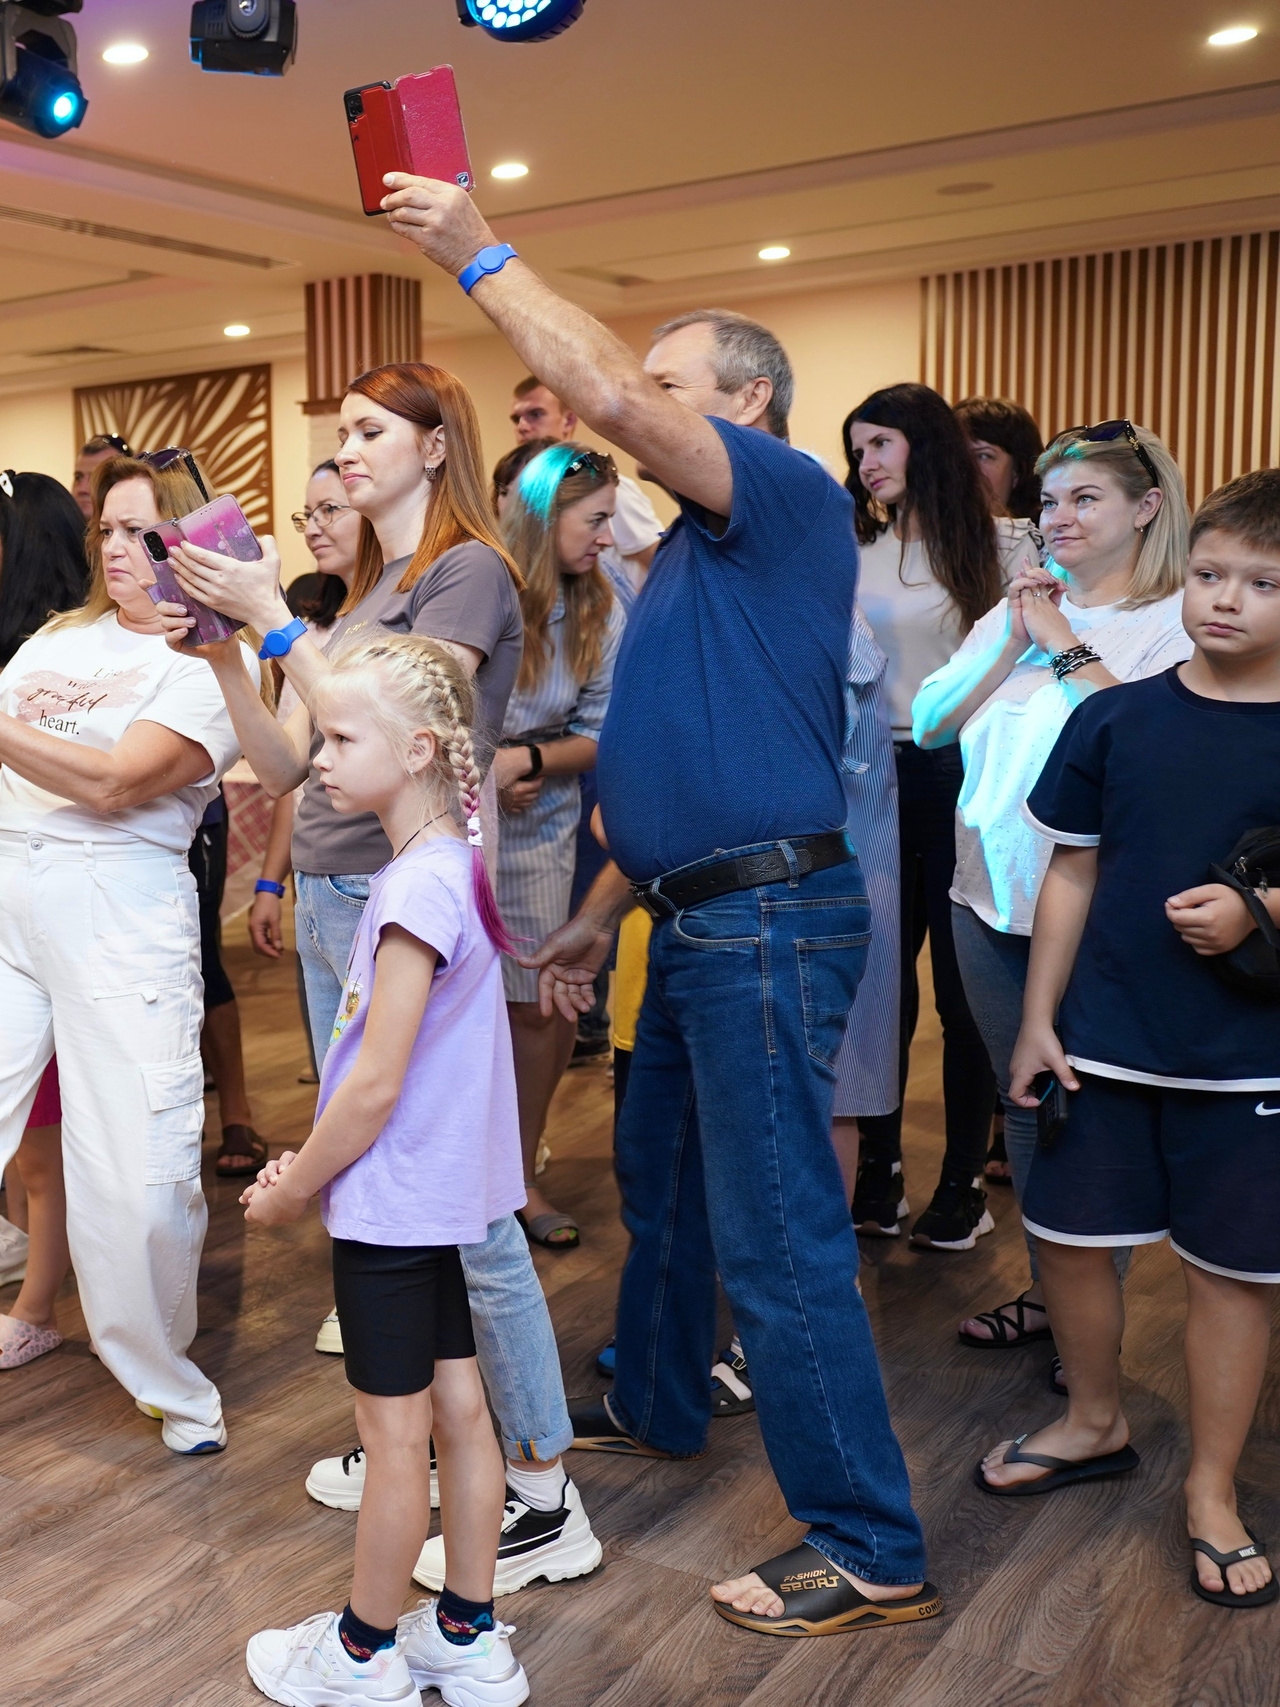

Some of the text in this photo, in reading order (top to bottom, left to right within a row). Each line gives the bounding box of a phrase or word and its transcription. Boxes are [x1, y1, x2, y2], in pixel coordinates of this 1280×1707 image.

[39, 709, 80, 735] heart.
[780, 1575, 840, 1593] SPORT
[783, 1568, 827, 1582] FASHION
[918, 1597, 943, 1616] COMF
